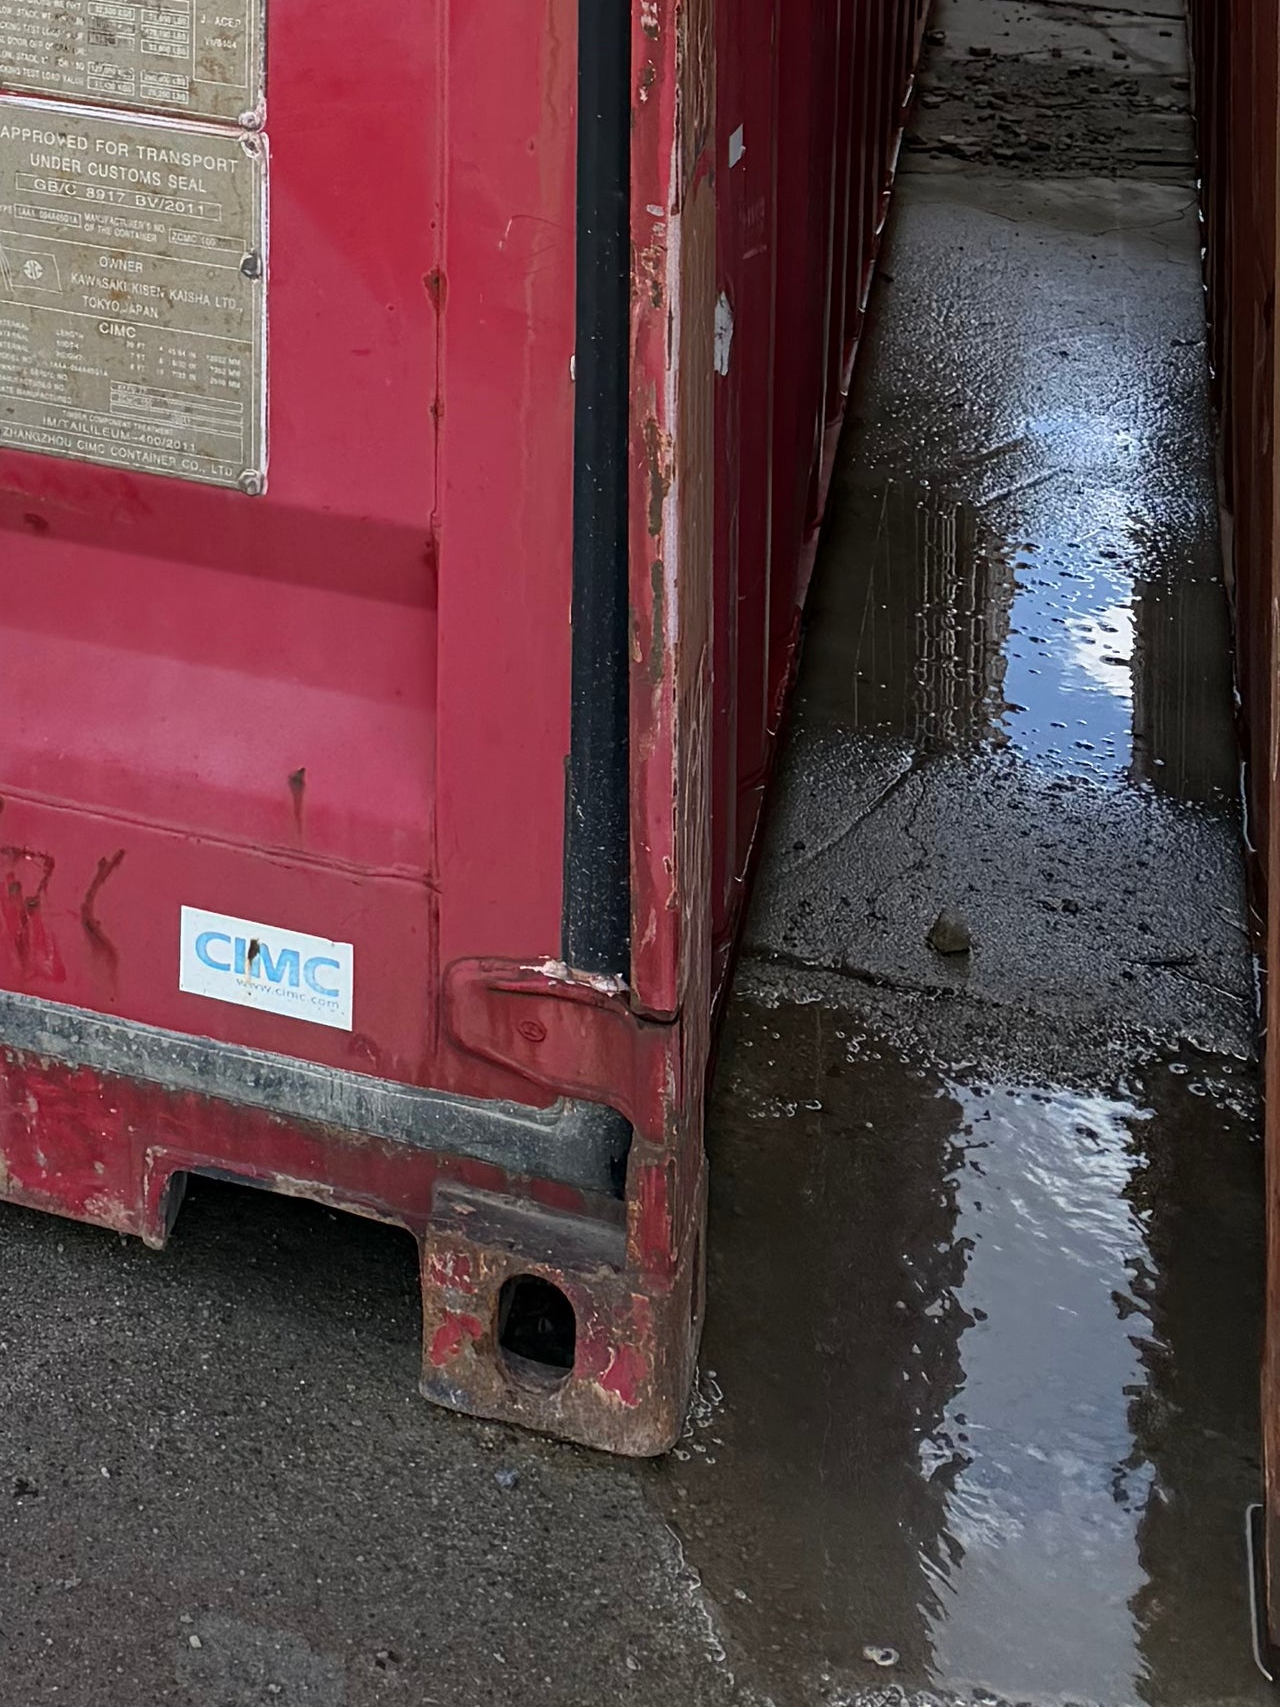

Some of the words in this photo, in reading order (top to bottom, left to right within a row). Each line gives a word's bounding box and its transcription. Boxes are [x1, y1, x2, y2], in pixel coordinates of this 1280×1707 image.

[0, 125, 88, 150] APPROVED
[95, 139, 129, 157] FOR
[136, 145, 239, 173] TRANSPORT
[30, 153, 81, 173] UNDER
[88, 162, 161, 186] CUSTOMS
[168, 174, 207, 193] SEAL
[34, 178, 77, 195] GB/C
[86, 187, 126, 203] 8917
[135, 195, 204, 216] BV/2011
[99, 256, 143, 273] OWNER
[169, 289, 211, 306] KAISHA
[98, 322, 137, 338] CIMC
[3, 426, 71, 447] ZHANGZHOU
[77, 440, 105, 454] CIMC
[111, 446, 176, 466] CONTAINER
[195, 931, 340, 998] CIMC
